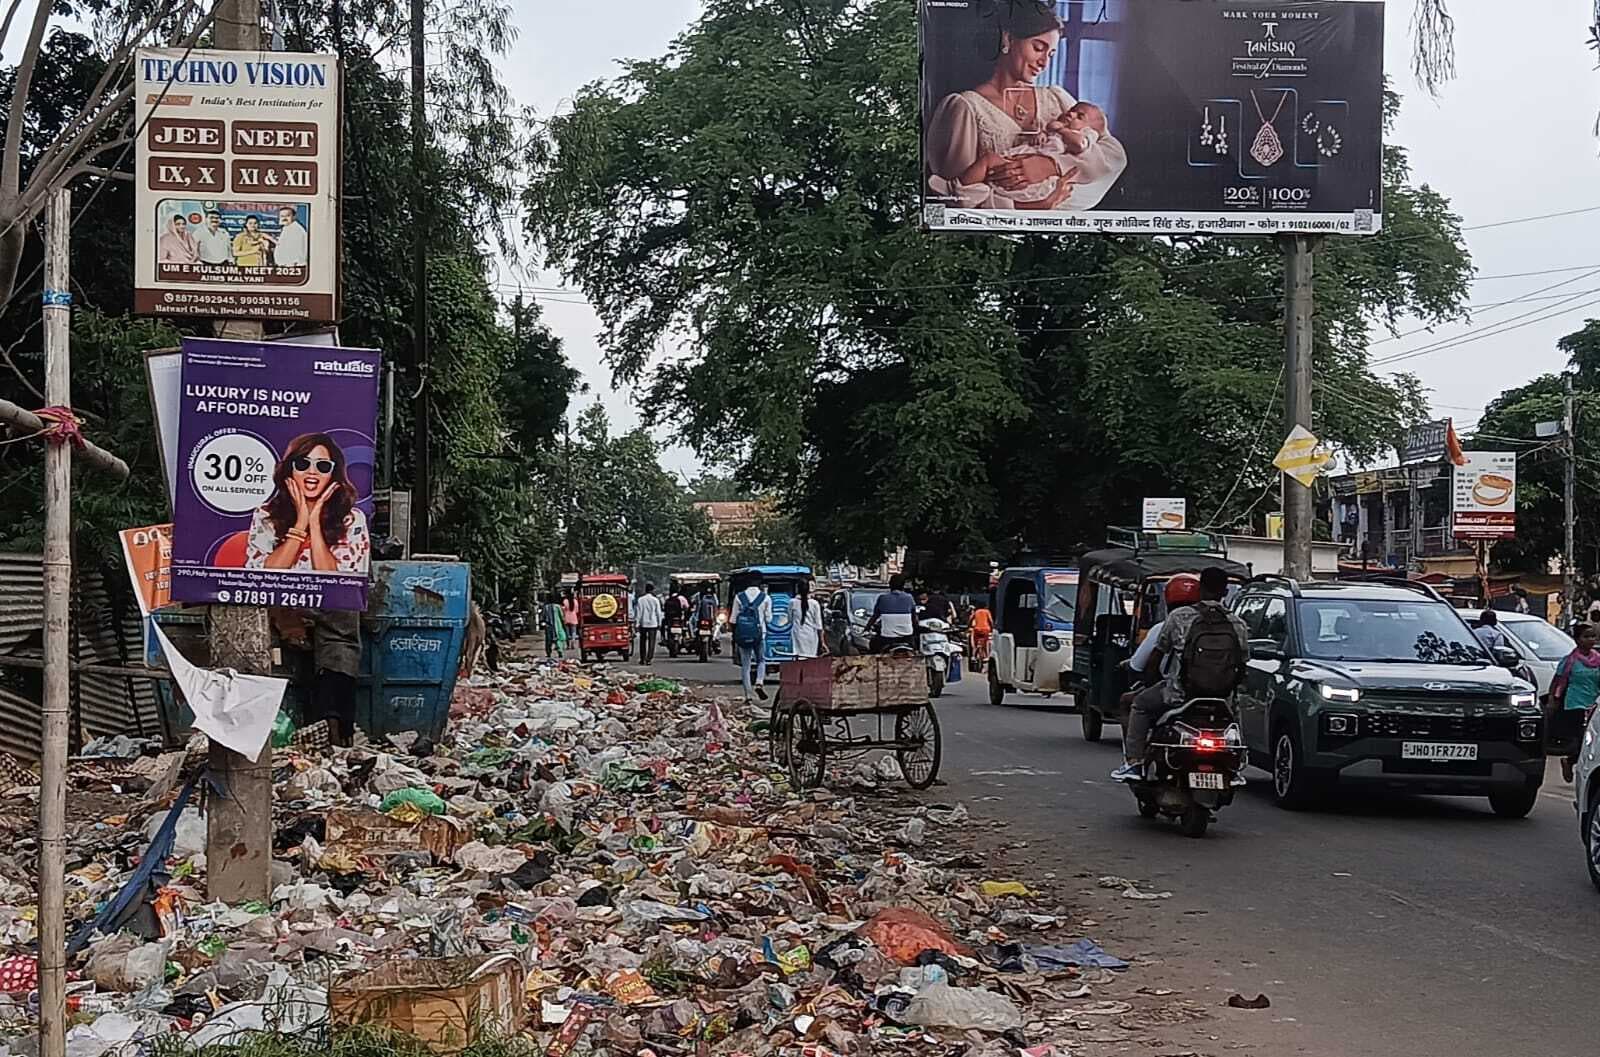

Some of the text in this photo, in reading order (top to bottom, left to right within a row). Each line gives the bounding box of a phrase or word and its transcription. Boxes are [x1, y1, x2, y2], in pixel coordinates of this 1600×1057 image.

[1252, 11, 1277, 19] YOUR
[1281, 12, 1319, 20] MOMENT
[141, 59, 327, 87] TECHNO VISION
[1232, 62, 1260, 71] Festival
[1272, 63, 1307, 71] Diamonds
[200, 97, 233, 106] India's
[236, 98, 256, 107] Best
[258, 98, 306, 108] Institution
[306, 99, 323, 109] for
[154, 126, 220, 146] JEE
[235, 129, 314, 148] NEET
[158, 165, 216, 187] IX, X
[239, 168, 311, 187] XI & XII
[162, 264, 302, 276] UM E KULSUM, NEET 2023
[314, 360, 374, 373] naturals
[186, 384, 312, 404] LUXURY IS NOW
[196, 401, 300, 418] AFFORDABLE
[213, 427, 237, 437] OFFER
[244, 473, 268, 484] OFF
[230, 487, 265, 495] SERVICES
[234, 590, 323, 608] 87891 26417
[1409, 744, 1476, 758] JH01FR7278
